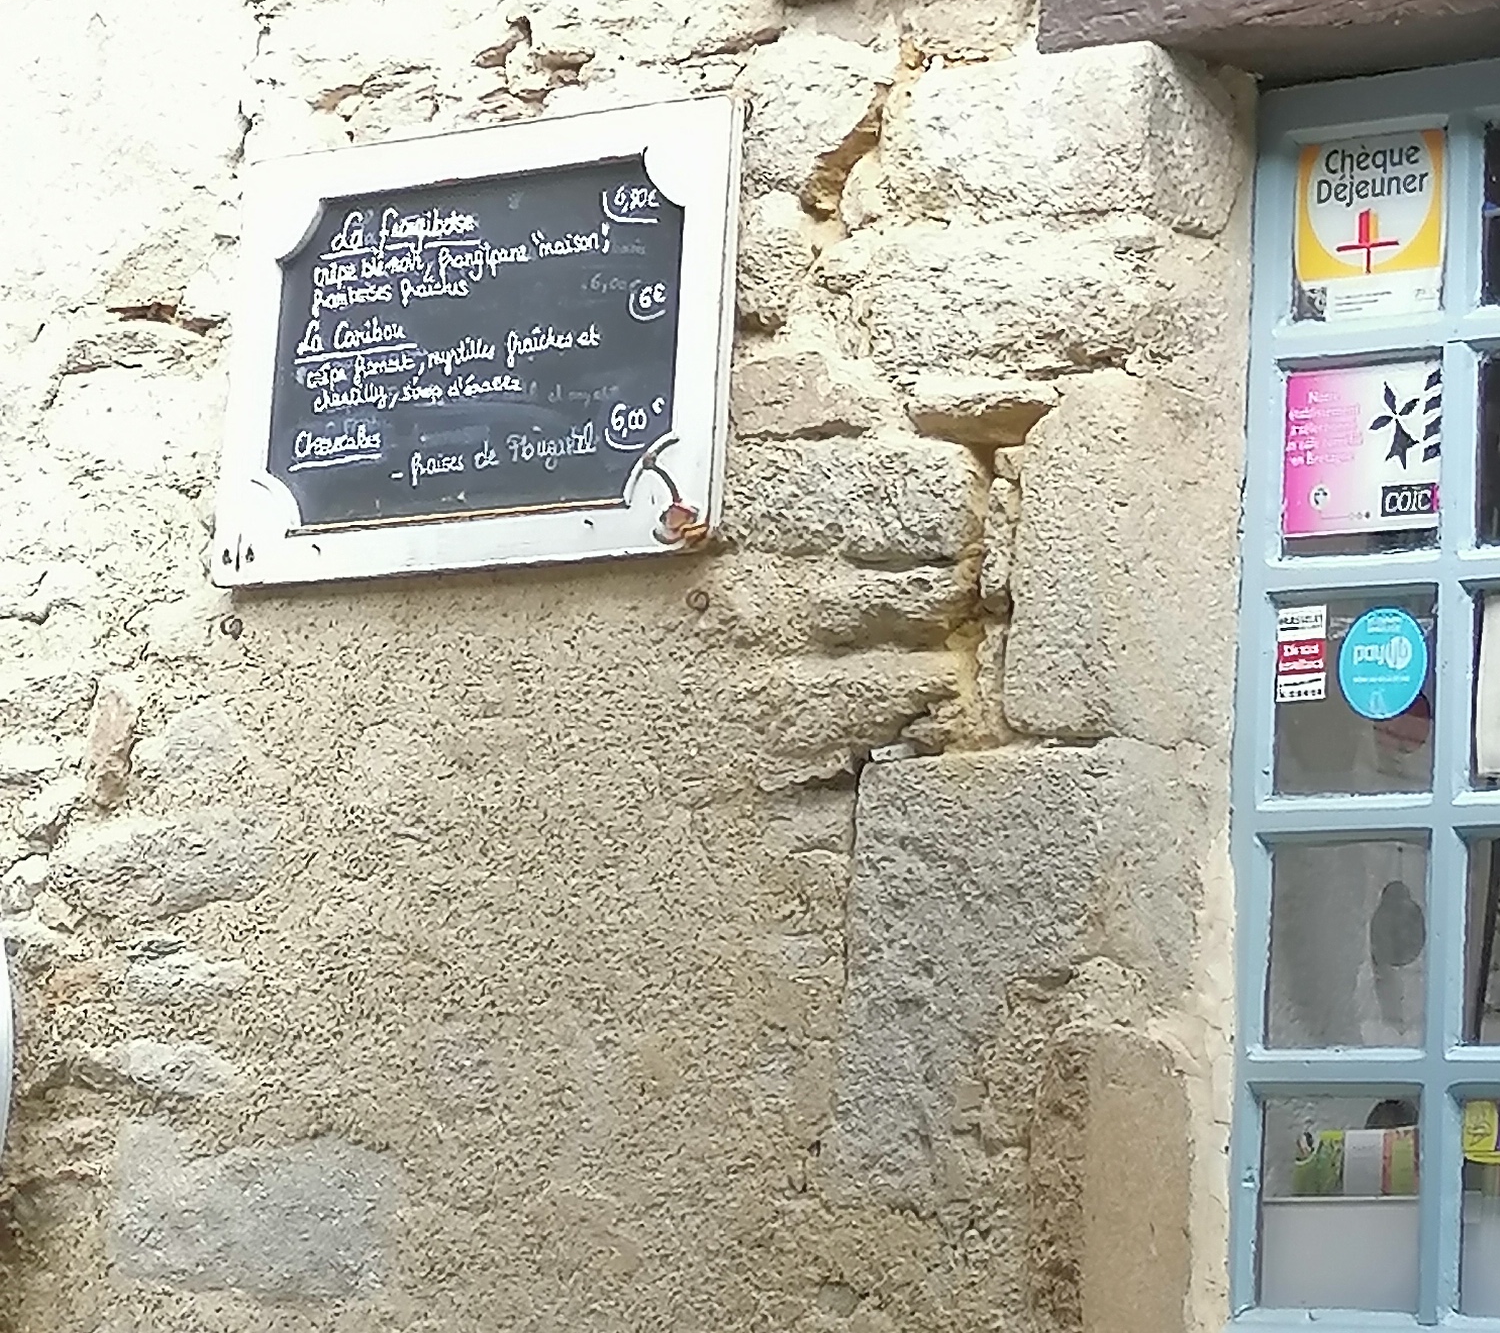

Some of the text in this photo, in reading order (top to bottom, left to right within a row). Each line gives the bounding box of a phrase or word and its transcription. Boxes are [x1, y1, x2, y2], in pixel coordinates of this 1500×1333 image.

[1325, 144, 1421, 174] Chèque
[1316, 172, 1429, 208] Déjeuner
[331, 210, 364, 251] La
[296, 315, 407, 356] La Caribou
[427, 336, 496, 376] myrtilles
[507, 326, 575, 369] fraîches
[577, 323, 603, 347] et
[410, 451, 465, 487] fraises
[474, 439, 501, 471] de
